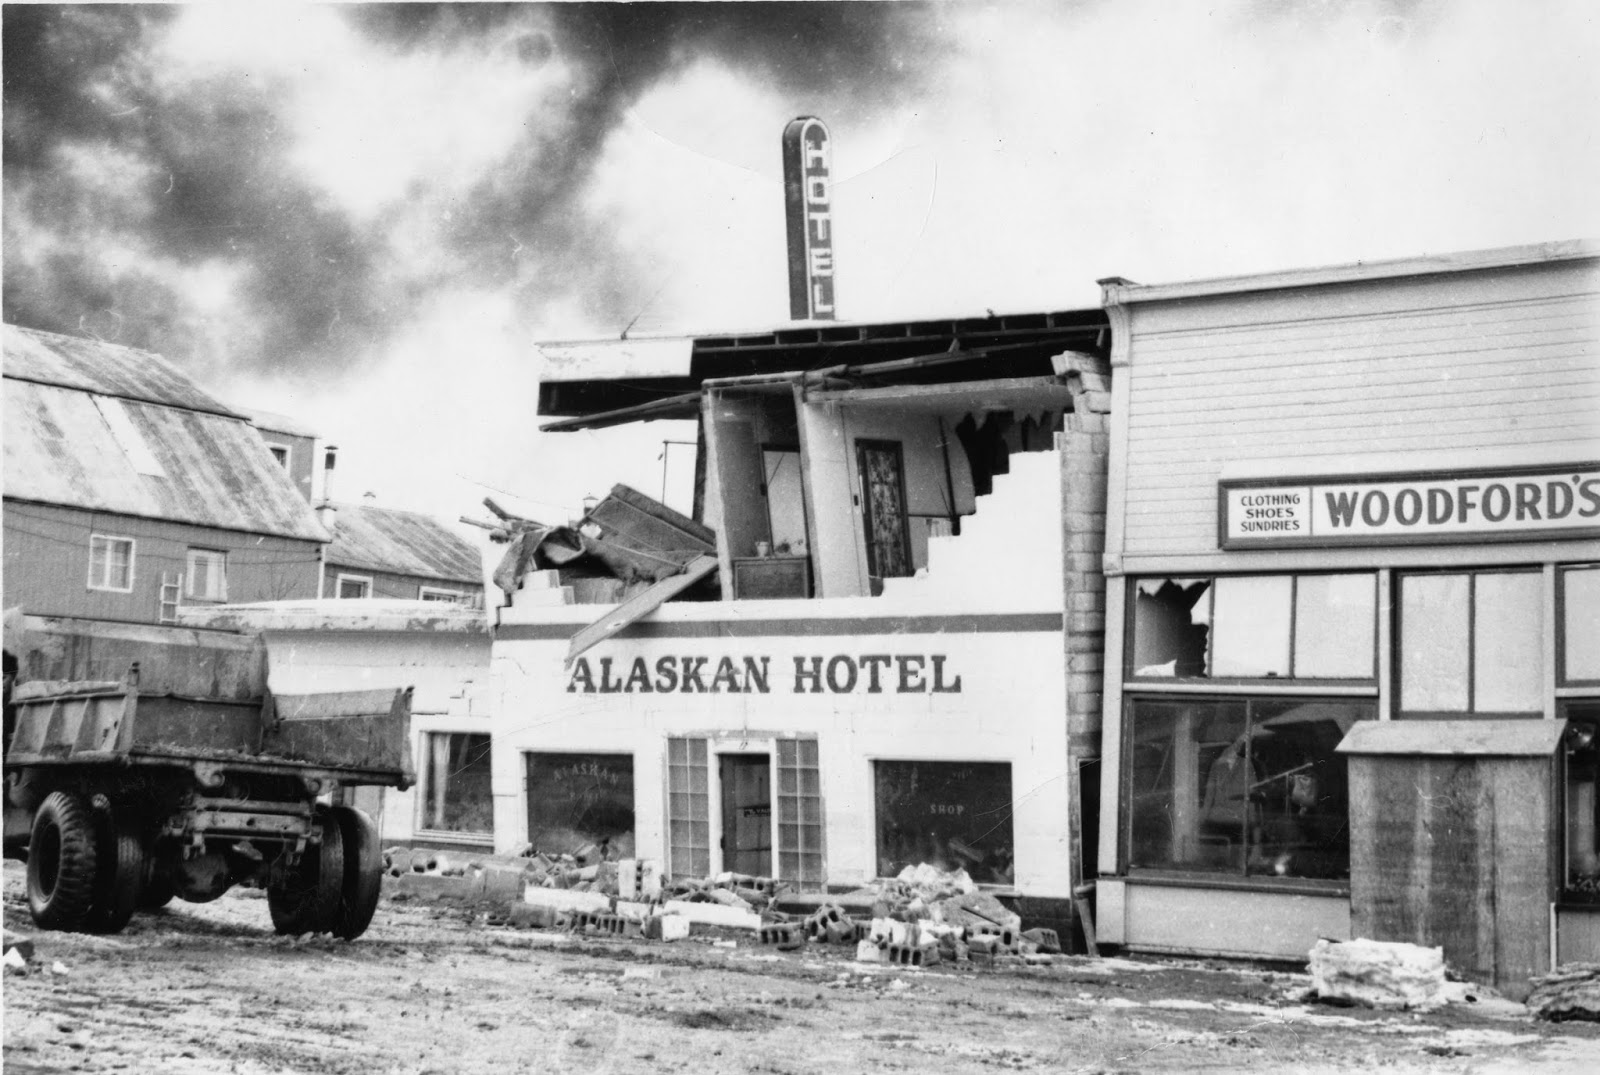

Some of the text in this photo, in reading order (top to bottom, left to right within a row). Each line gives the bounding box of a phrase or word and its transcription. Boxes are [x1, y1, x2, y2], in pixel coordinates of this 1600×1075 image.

[805, 140, 833, 313] HOTEL
[1241, 494, 1301, 506] CLOTHING
[1325, 474, 1600, 528] WOODFORD'S
[1241, 520, 1300, 532] SUNDRIES
[1246, 508, 1294, 519] SHOES
[567, 656, 771, 693] ALASKAN
[793, 655, 962, 693] HOTEL
[929, 803, 965, 816] SHOP
